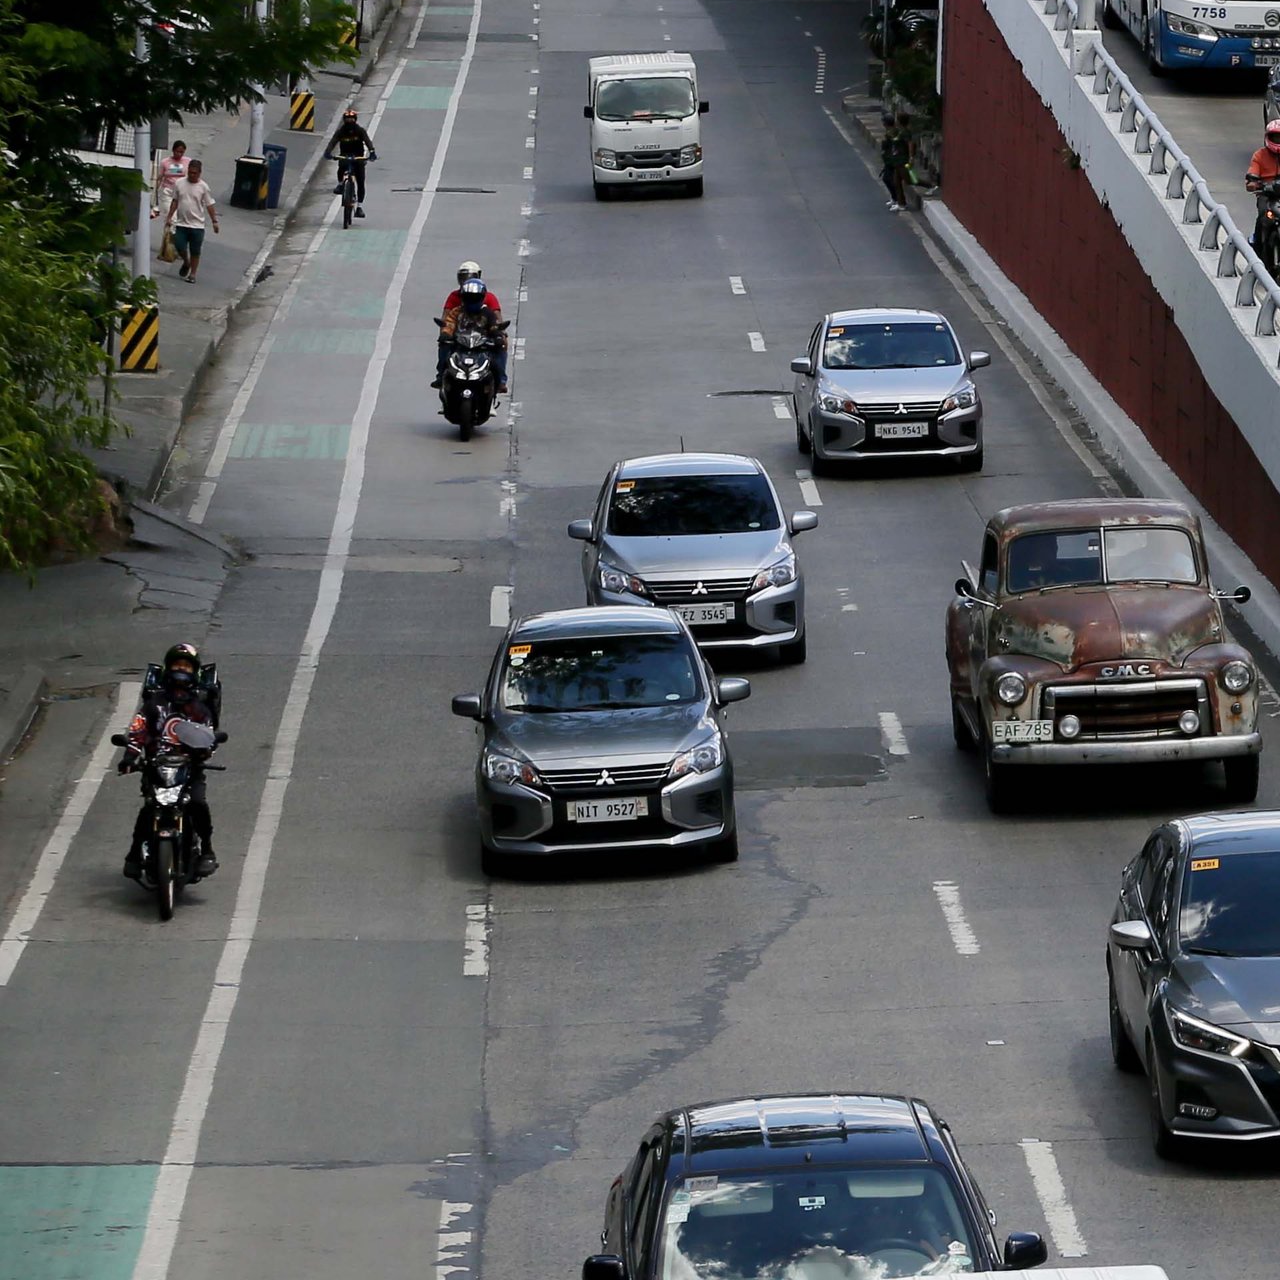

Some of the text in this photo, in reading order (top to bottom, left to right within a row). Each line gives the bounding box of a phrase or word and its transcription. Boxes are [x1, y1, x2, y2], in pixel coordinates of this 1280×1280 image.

[1191, 6, 1227, 19] 7758
[901, 425, 922, 435] 9541
[701, 608, 725, 620] 3545
[1101, 665, 1150, 677] GMC
[994, 723, 1051, 738] EAF 785
[577, 803, 635, 819] NIT 9527
